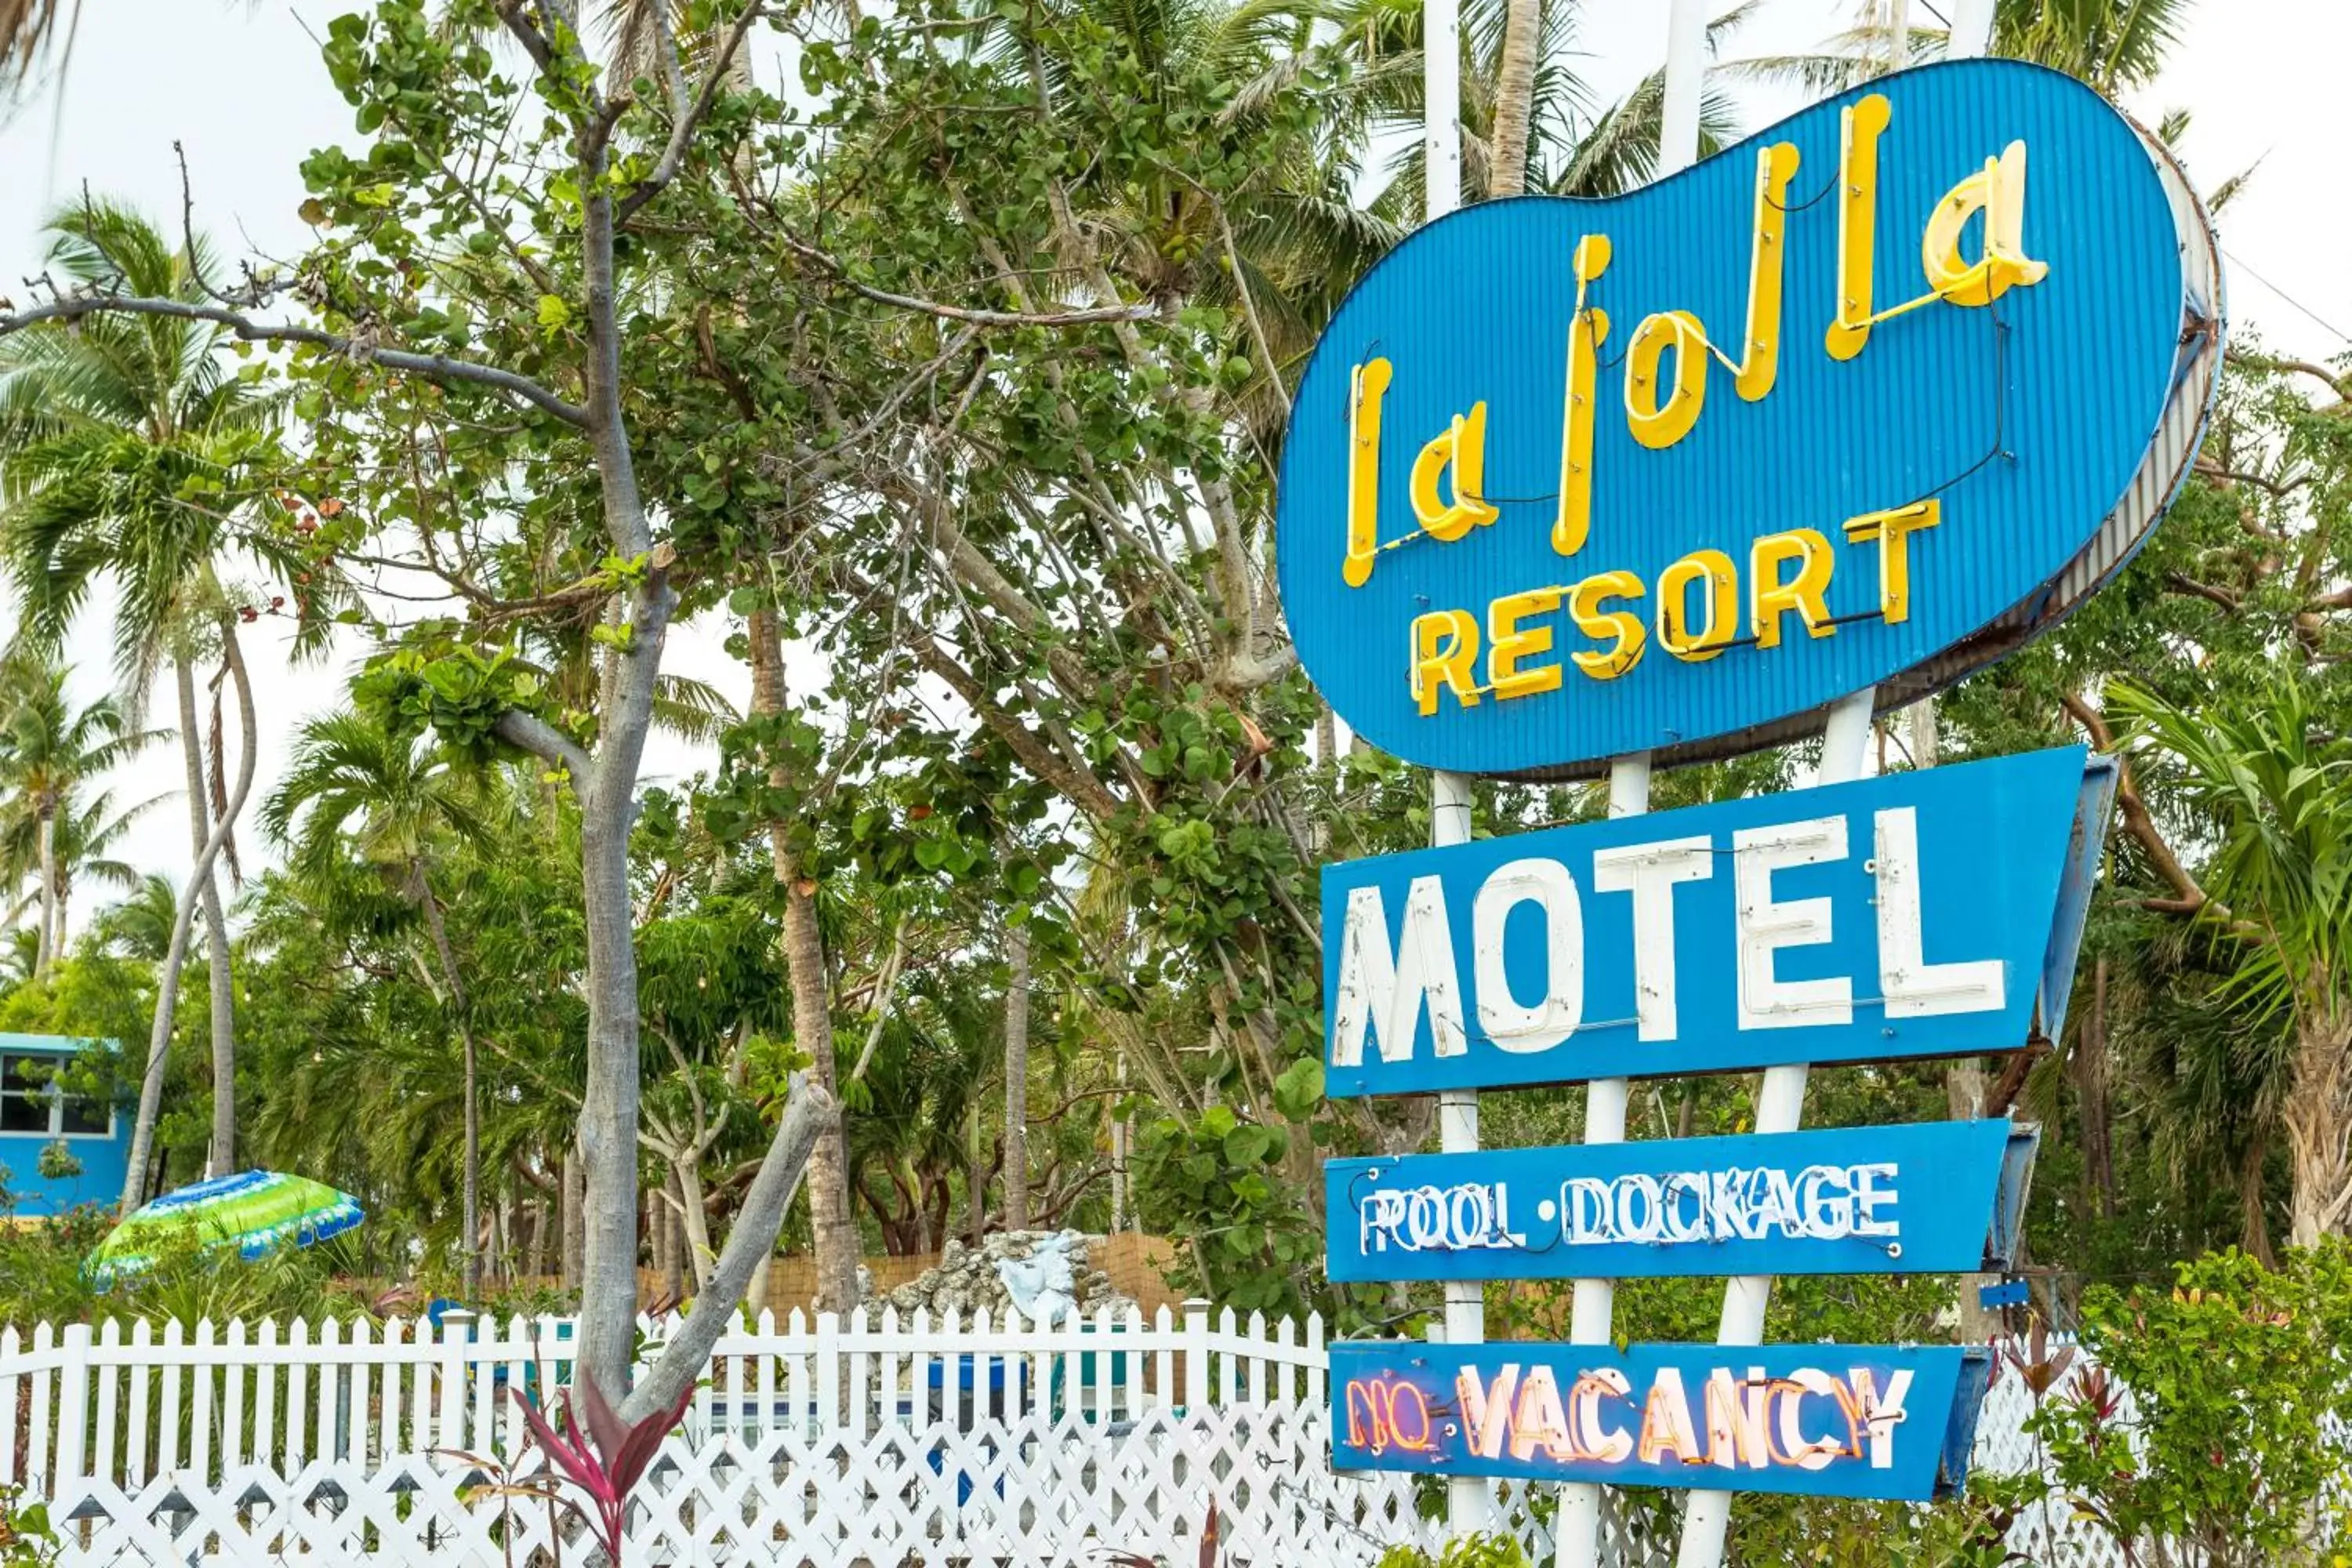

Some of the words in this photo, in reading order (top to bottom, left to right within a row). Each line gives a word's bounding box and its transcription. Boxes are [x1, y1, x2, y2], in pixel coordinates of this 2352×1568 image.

[1410, 498, 1941, 716] RESORT
[1331, 806, 2005, 1068] MOTEL
[1360, 1182, 1526, 1256] POOL
[1560, 1162, 1899, 1245] DOCKAGE
[1345, 1377, 1430, 1452] NO
[1455, 1363, 1915, 1470] VACANCY
